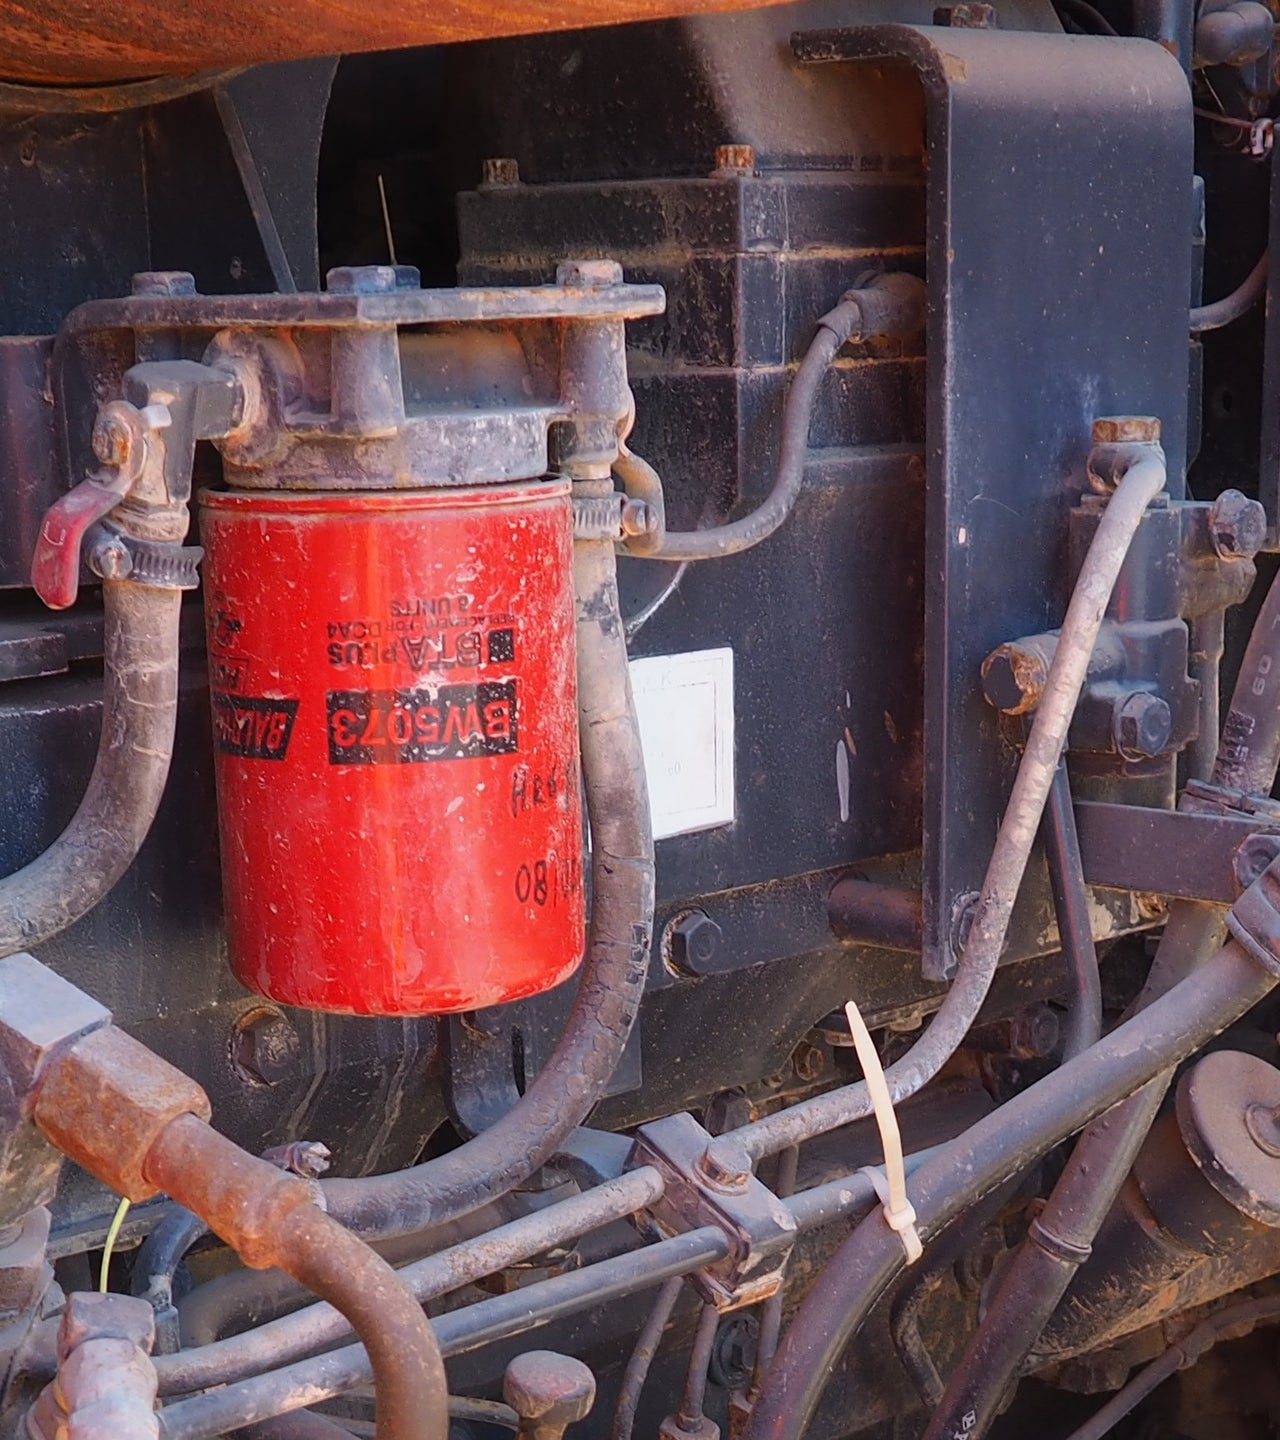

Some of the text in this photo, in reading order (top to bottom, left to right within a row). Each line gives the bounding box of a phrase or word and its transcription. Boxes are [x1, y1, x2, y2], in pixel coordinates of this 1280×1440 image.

[327, 621, 382, 640] DCA4
[327, 631, 483, 672] BTA PLUS
[331, 699, 512, 747] BW5073
